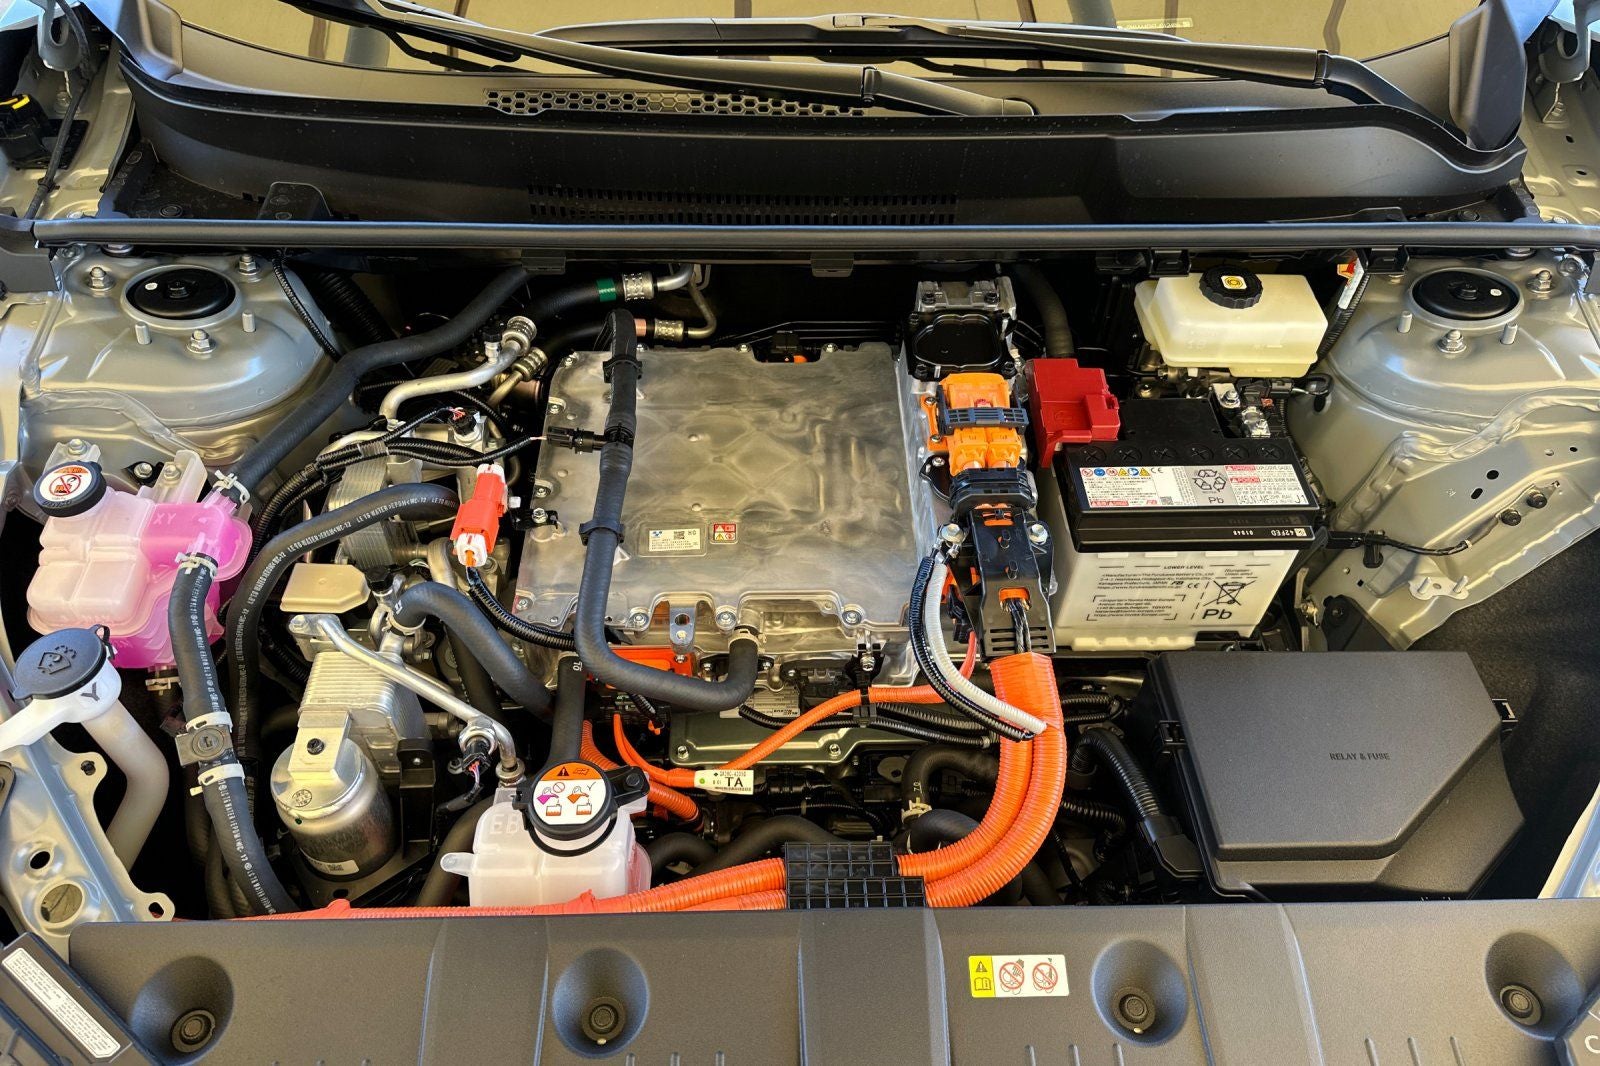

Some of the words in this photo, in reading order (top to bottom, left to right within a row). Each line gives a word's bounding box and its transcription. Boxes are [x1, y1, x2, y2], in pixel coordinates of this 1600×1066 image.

[1208, 496, 1224, 504] Pb
[153, 512, 177, 525] XY
[1202, 609, 1232, 620] Pb
[81, 681, 102, 702] Y
[1329, 752, 1357, 761] RELAY
[1359, 752, 1366, 760] &
[1367, 752, 1391, 760] FUSE
[724, 776, 744, 787] TA
